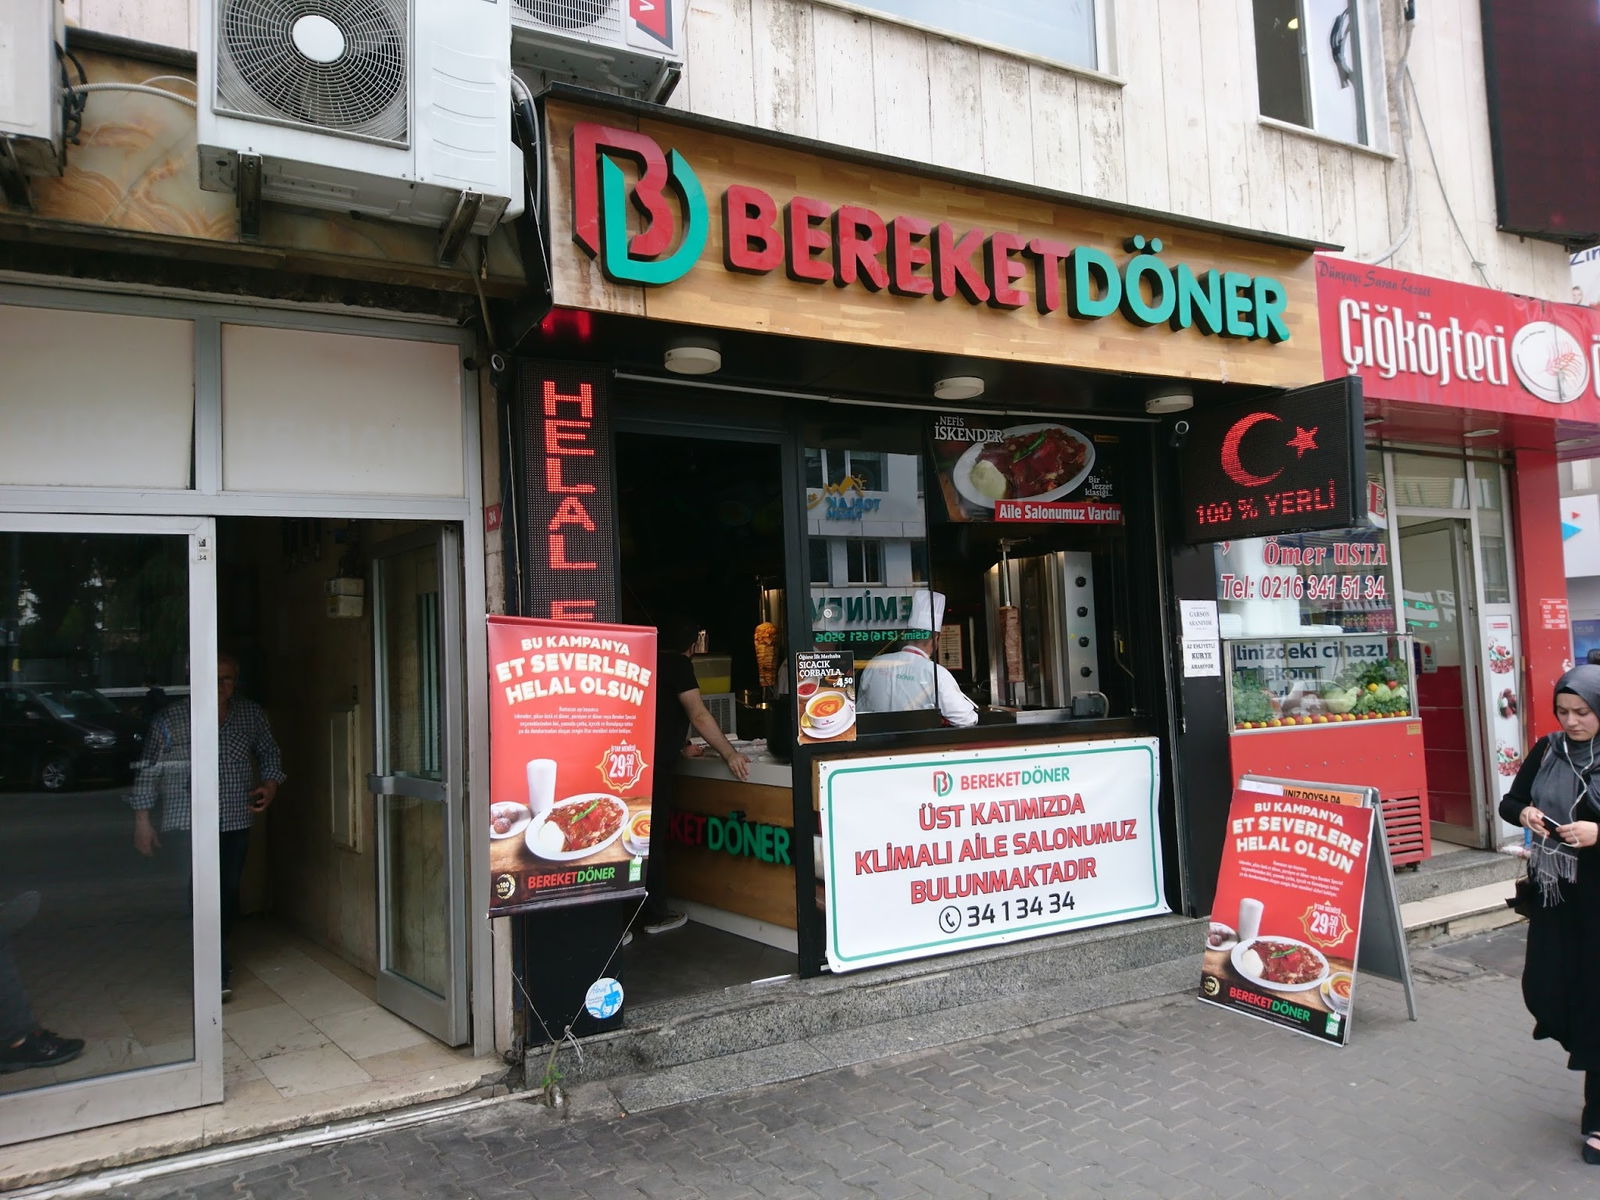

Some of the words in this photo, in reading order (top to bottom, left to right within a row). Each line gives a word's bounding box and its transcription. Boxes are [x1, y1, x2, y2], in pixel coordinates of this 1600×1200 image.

[1338, 297, 1509, 386] Çiğköfteci
[934, 421, 1004, 443] İSKENDER
[940, 416, 965, 427] NEFİS
[543, 380, 597, 570] HELAL
[1000, 504, 1021, 519] Aile
[1024, 504, 1085, 520] Salonumuz
[1087, 505, 1121, 521] Vardır
[1195, 501, 1232, 525] 100
[1238, 498, 1258, 521] %
[1264, 478, 1336, 517] YERLİ
[1263, 536, 1326, 566] Ömer
[1333, 543, 1388, 566] USTA
[1221, 573, 1255, 600] Tel:
[1260, 574, 1304, 600] 0216
[1307, 574, 1337, 600] 341
[1341, 574, 1360, 600] 51
[1365, 574, 1385, 600] 34
[521, 637, 543, 651] BU
[546, 635, 630, 656] KAMPANYA
[495, 657, 526, 683] ET
[530, 652, 652, 688] SEVERLERE
[799, 660, 831, 669] SICACIK
[505, 676, 577, 706] HELAL
[580, 676, 645, 706] OLSUN
[918, 803, 964, 830] ÜST
[970, 793, 1085, 826] KATIMIZDA
[1254, 802, 1271, 813] BU
[1273, 802, 1344, 827] KAMPANYA
[854, 842, 952, 875] KLİMALI
[958, 832, 1008, 862] AİLE
[1012, 818, 1137, 855] SALONUMUZ
[1232, 817, 1255, 835] ET
[1258, 816, 1364, 857] SEVERLERE
[1236, 836, 1291, 853] HELAL
[1294, 839, 1355, 874] OLSUN
[910, 856, 1097, 905] BULUNMAKTADIR
